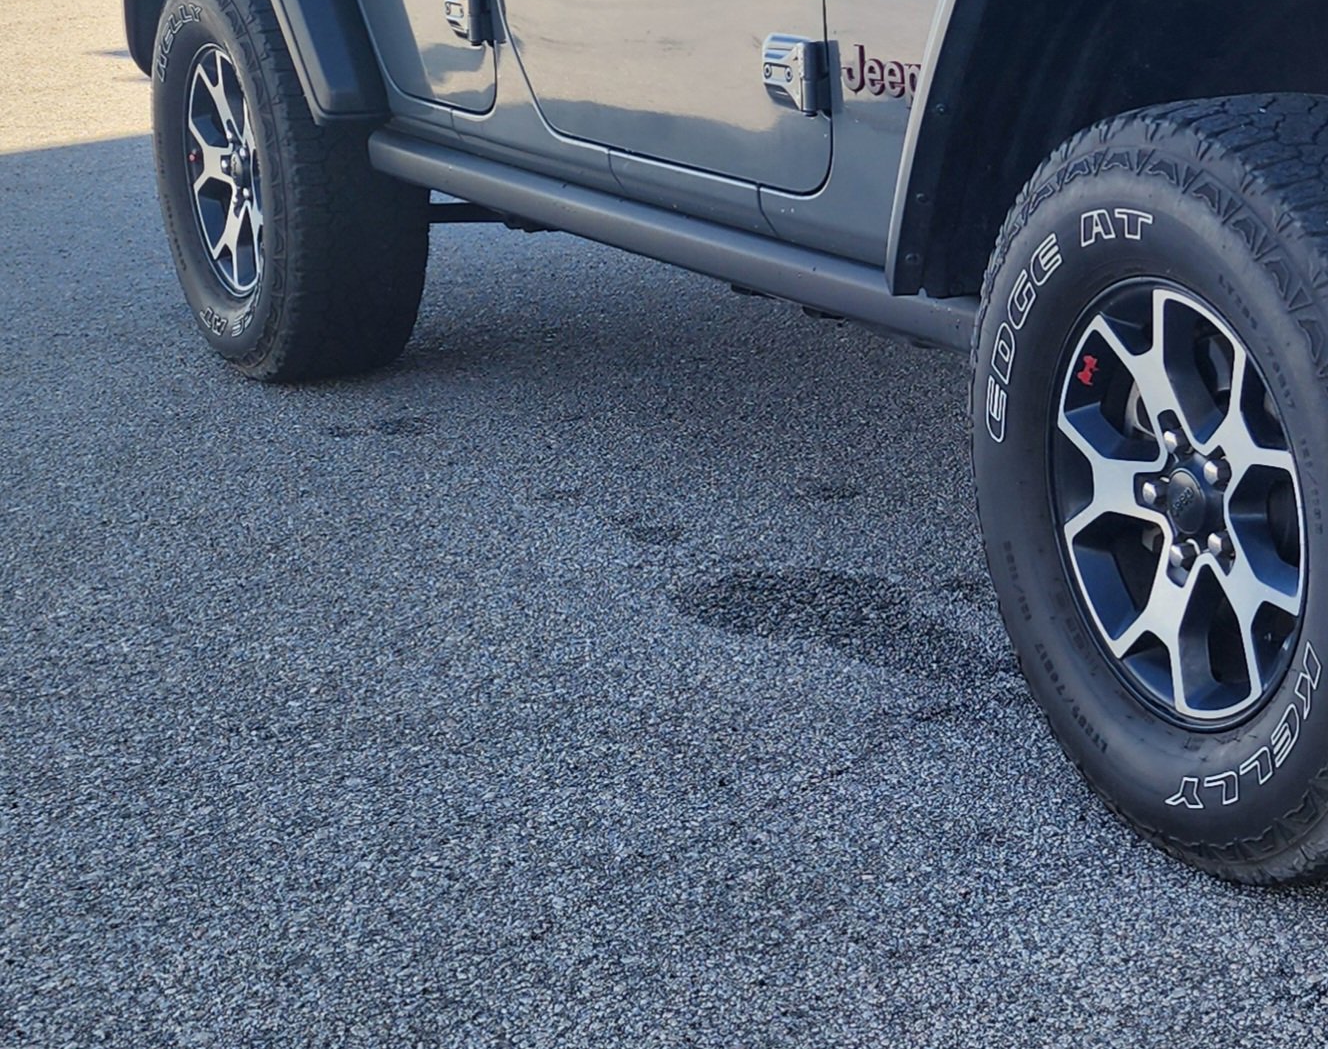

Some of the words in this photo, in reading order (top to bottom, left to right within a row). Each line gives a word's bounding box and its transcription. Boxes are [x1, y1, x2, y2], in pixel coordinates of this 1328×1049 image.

[156, 3, 203, 83] KELLY
[986, 233, 1063, 443] EDGE
[1081, 208, 1153, 247] AT
[1165, 641, 1322, 809] KELLY
